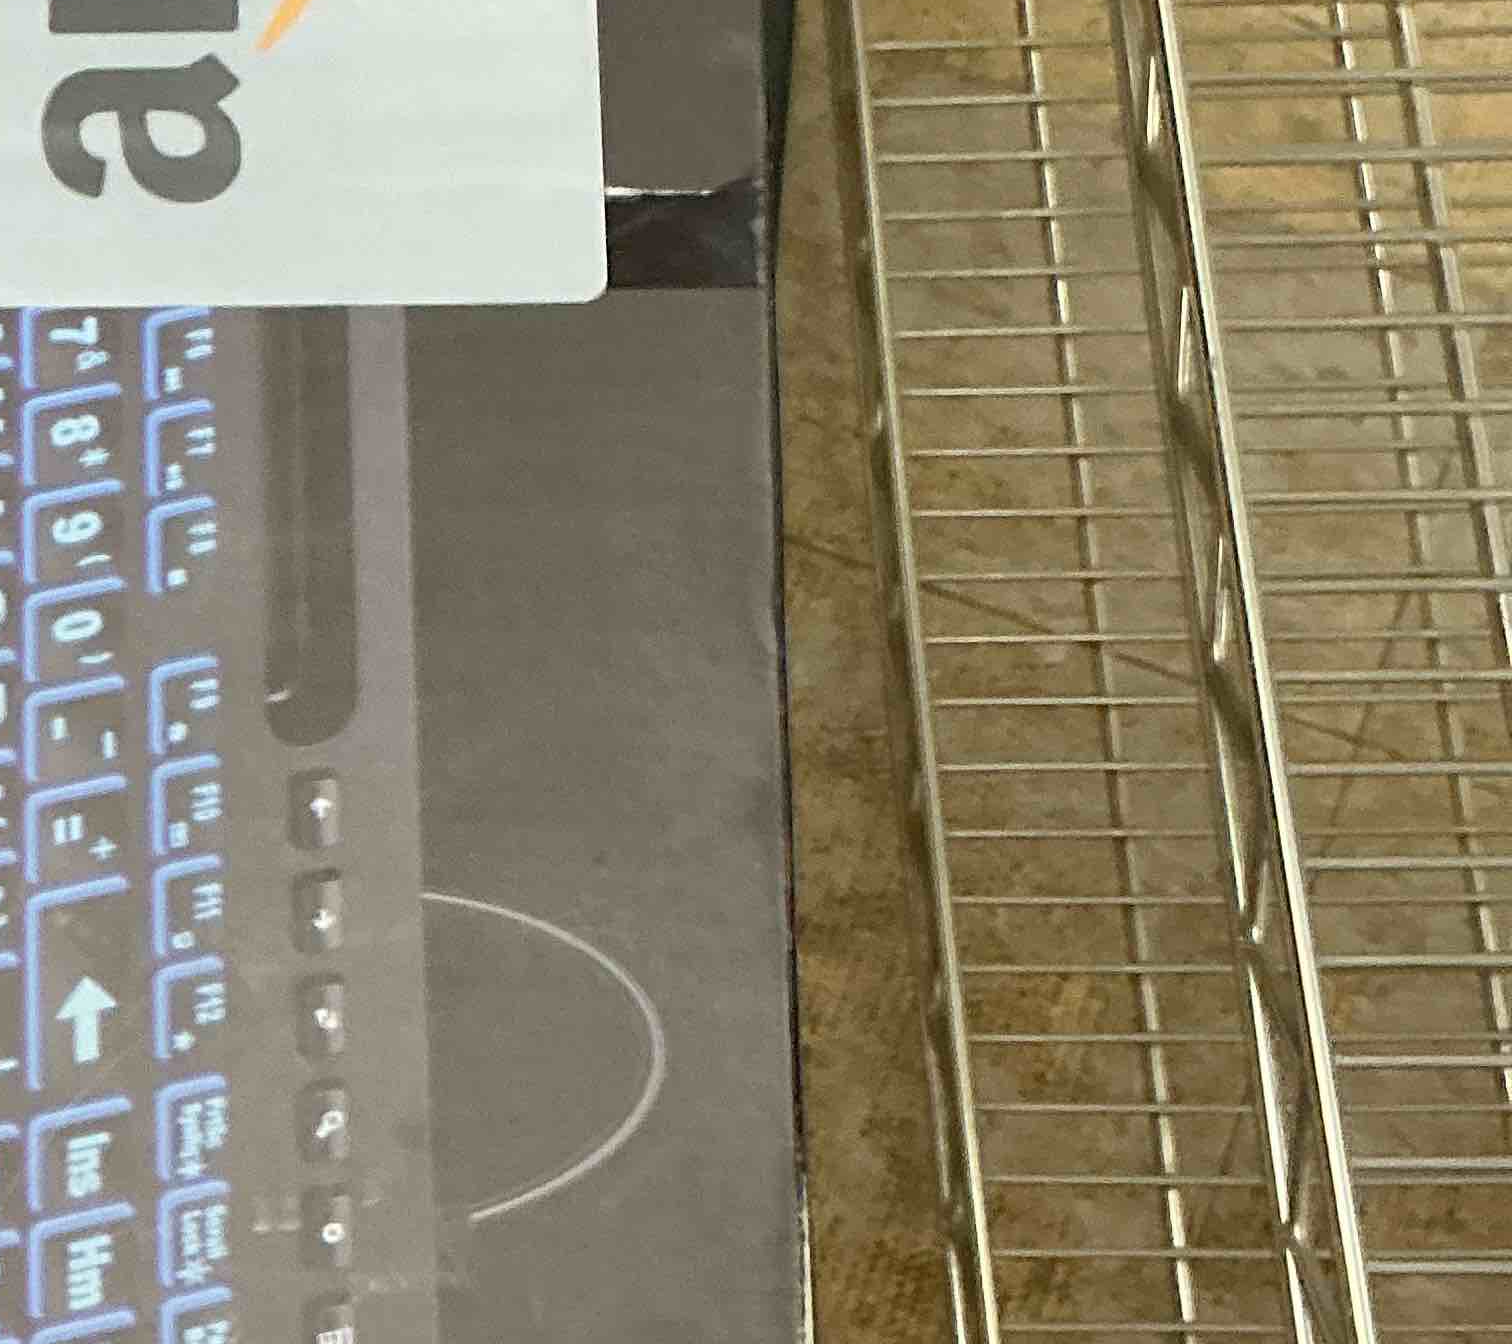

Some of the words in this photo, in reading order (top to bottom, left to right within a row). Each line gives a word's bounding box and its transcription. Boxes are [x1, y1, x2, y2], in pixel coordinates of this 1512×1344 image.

[49, 414, 99, 447] 8
[50, 510, 101, 543] 9
[65, 1131, 110, 1198] Ins
[66, 1233, 112, 1310] Hm
